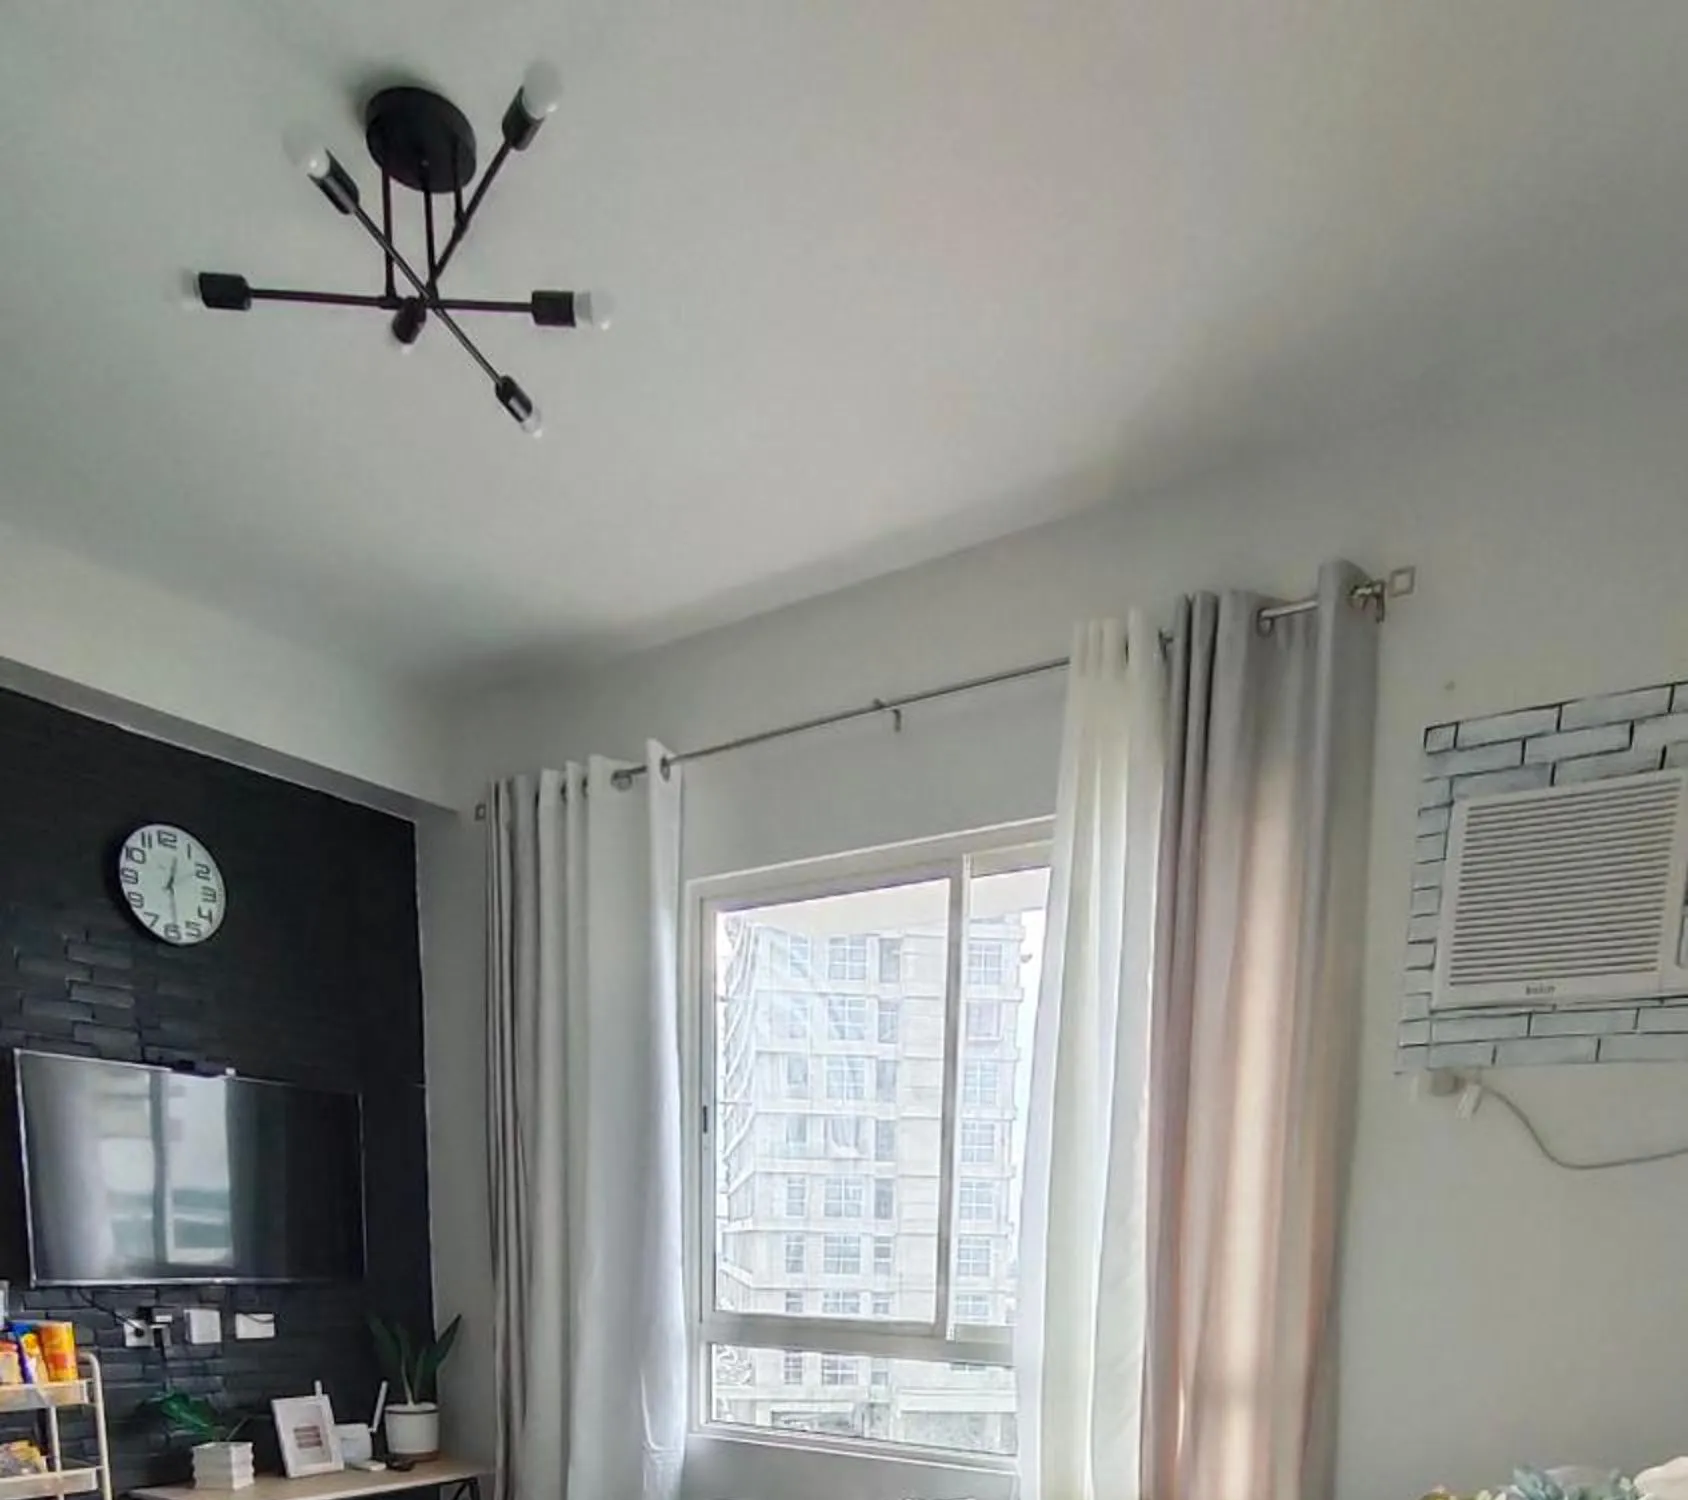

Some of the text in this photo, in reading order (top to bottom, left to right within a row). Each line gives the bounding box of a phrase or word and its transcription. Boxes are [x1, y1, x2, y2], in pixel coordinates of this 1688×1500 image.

[141, 831, 152, 848] 11
[157, 830, 177, 849] 12
[125, 846, 146, 864] 10
[121, 867, 139, 885] 9
[195, 862, 211, 881] 2
[128, 891, 144, 908] 8
[201, 886, 216, 902] 3
[144, 911, 160, 927] 7
[197, 905, 212, 925] 4
[164, 923, 182, 940] 6
[185, 920, 201, 938] 5
